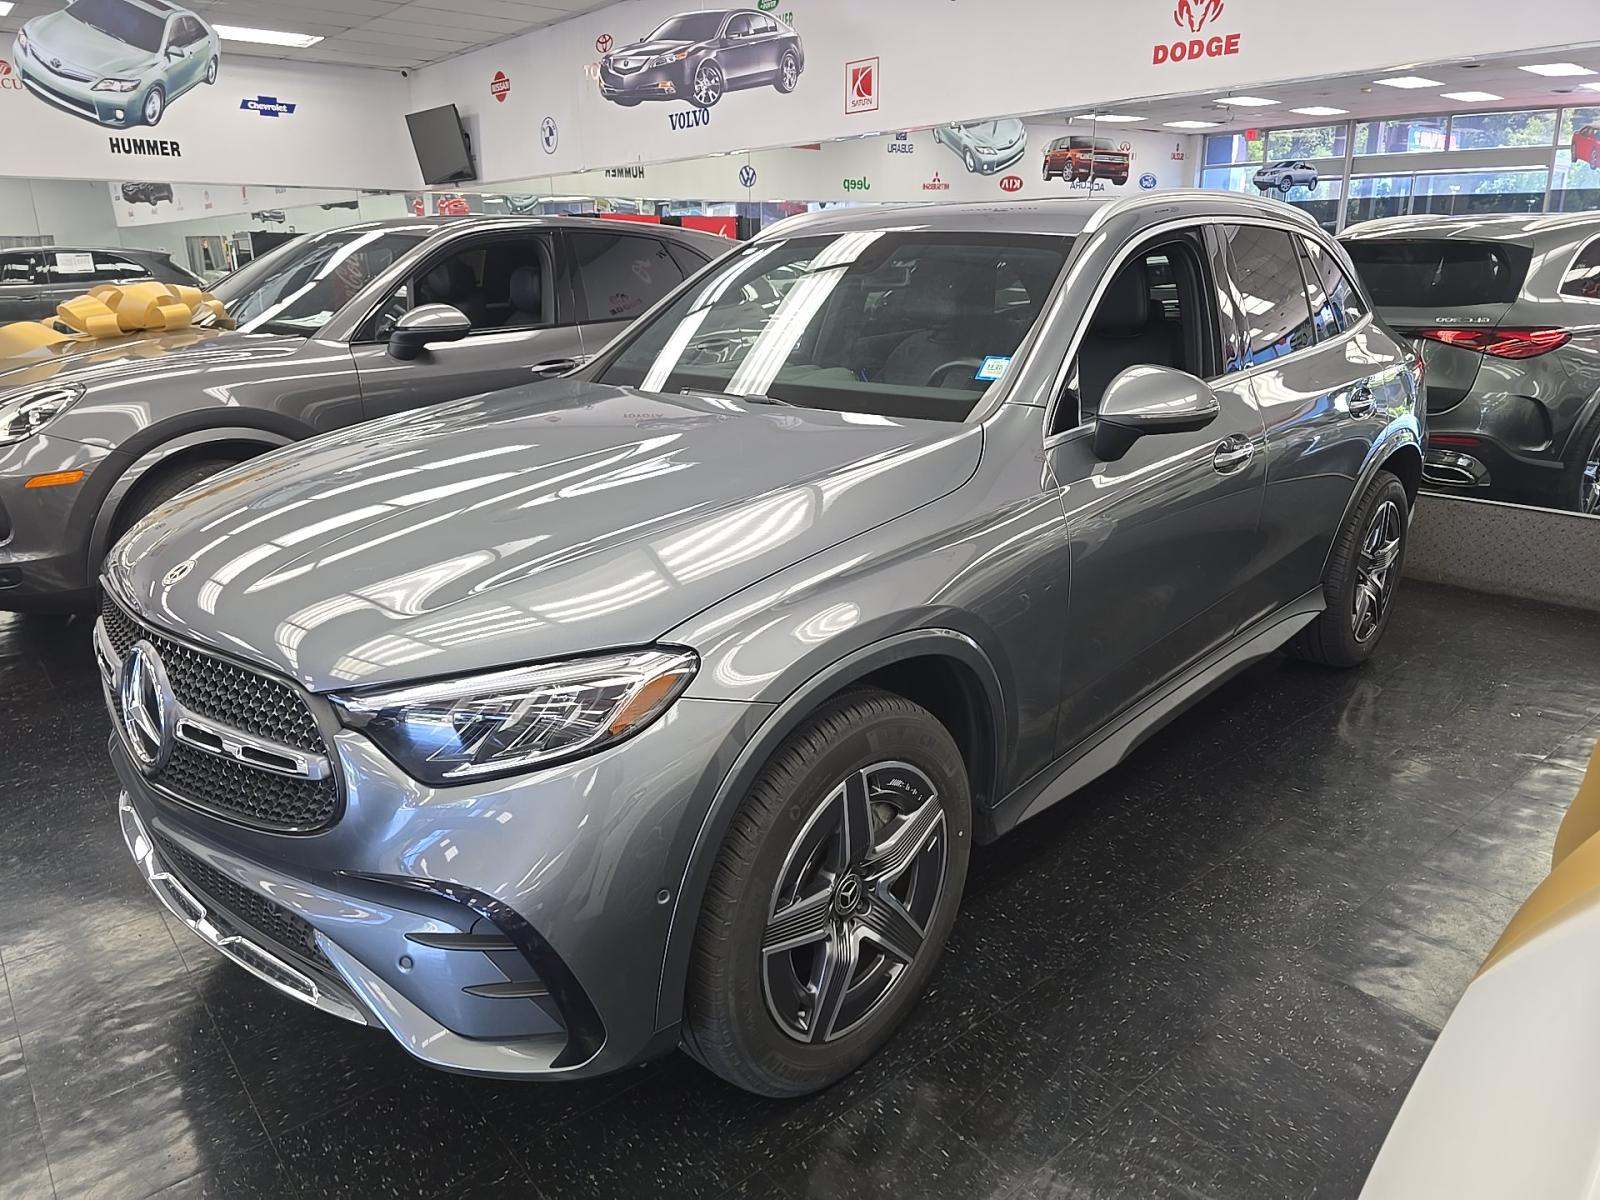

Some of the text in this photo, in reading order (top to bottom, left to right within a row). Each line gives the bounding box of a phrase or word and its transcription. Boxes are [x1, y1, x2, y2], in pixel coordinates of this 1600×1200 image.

[1153, 33, 1241, 64] DODGE
[248, 101, 288, 112] Chevrolet
[669, 108, 710, 130] VOLVO
[109, 137, 181, 157] HUMMER
